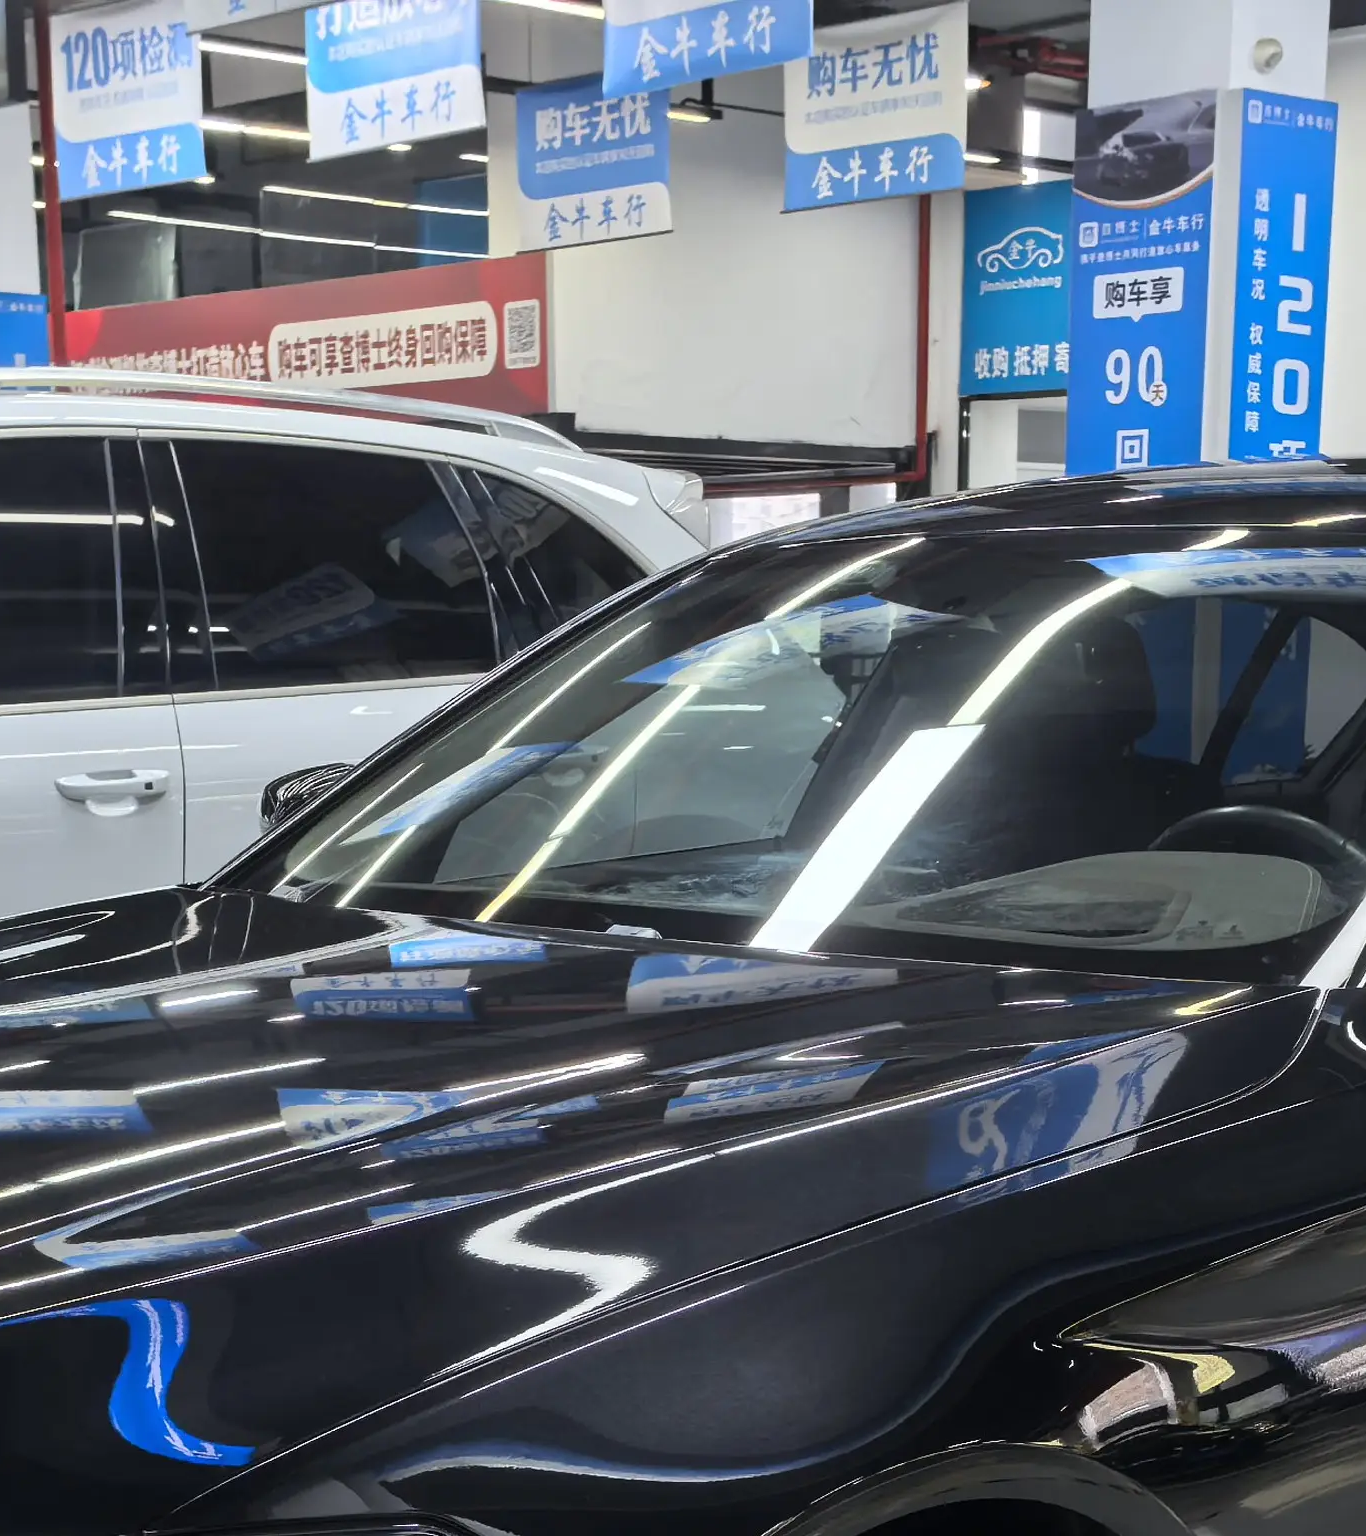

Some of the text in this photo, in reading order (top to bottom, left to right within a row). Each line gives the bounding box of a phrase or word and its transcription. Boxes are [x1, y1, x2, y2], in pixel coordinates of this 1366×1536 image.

[61, 22, 193, 92] 120项检测
[634, 5, 776, 82] 金牛车行
[807, 32, 939, 99] 购车无忧
[340, 80, 456, 145] 金牛车行
[535, 92, 651, 152] 购车无忧
[82, 134, 181, 189] 金牛车行
[811, 146, 933, 200] 金牛车行
[543, 193, 647, 242] 金牛车行
[1149, 213, 1204, 237] 金牛车行
[1104, 275, 1173, 309] 购车享
[278, 316, 488, 379] 购车可享查博士终身回购保障
[1269, 193, 1314, 458] 120
[974, 346, 1010, 380] 收购
[1014, 343, 1051, 377] 抵押
